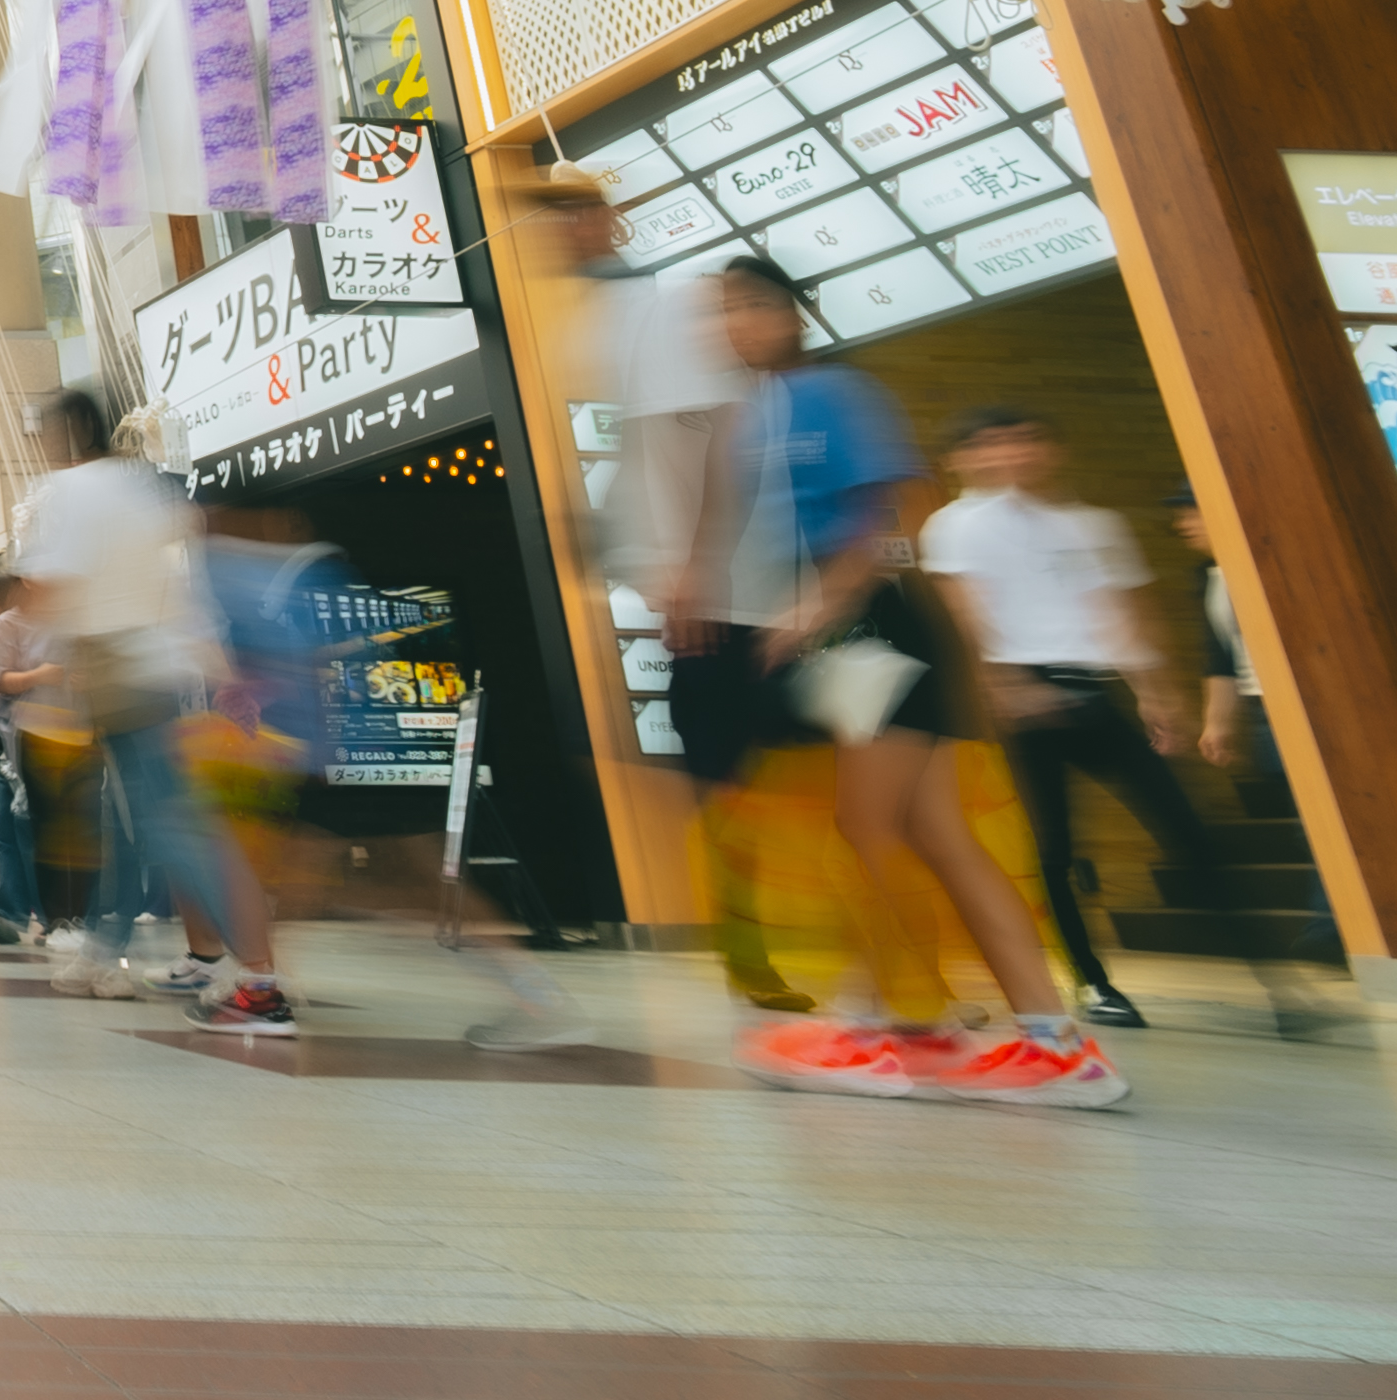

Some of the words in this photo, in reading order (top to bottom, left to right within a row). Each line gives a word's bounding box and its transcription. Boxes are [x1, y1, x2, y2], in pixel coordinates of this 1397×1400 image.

[895, 80, 989, 139] JAM
[731, 141, 818, 196] Euro-29
[960, 155, 1042, 200] 晴太
[774, 177, 815, 202] GENIE
[324, 225, 374, 240] Darts
[411, 213, 442, 246] &
[648, 203, 698, 234] PLAGE
[331, 251, 449, 281] カラオケ
[973, 246, 1036, 278] WEST
[1034, 224, 1103, 260] POINT
[334, 281, 411, 297] Karaoke
[267, 352, 292, 406] &
[297, 314, 397, 393] Party
[185, 458, 232, 500] ダーツ
[249, 425, 323, 478] カラオケ
[344, 384, 455, 444] パーティー
[351, 751, 396, 762] REGALO
[334, 768, 366, 782] ダーツ
[373, 768, 423, 782] カラオケ
